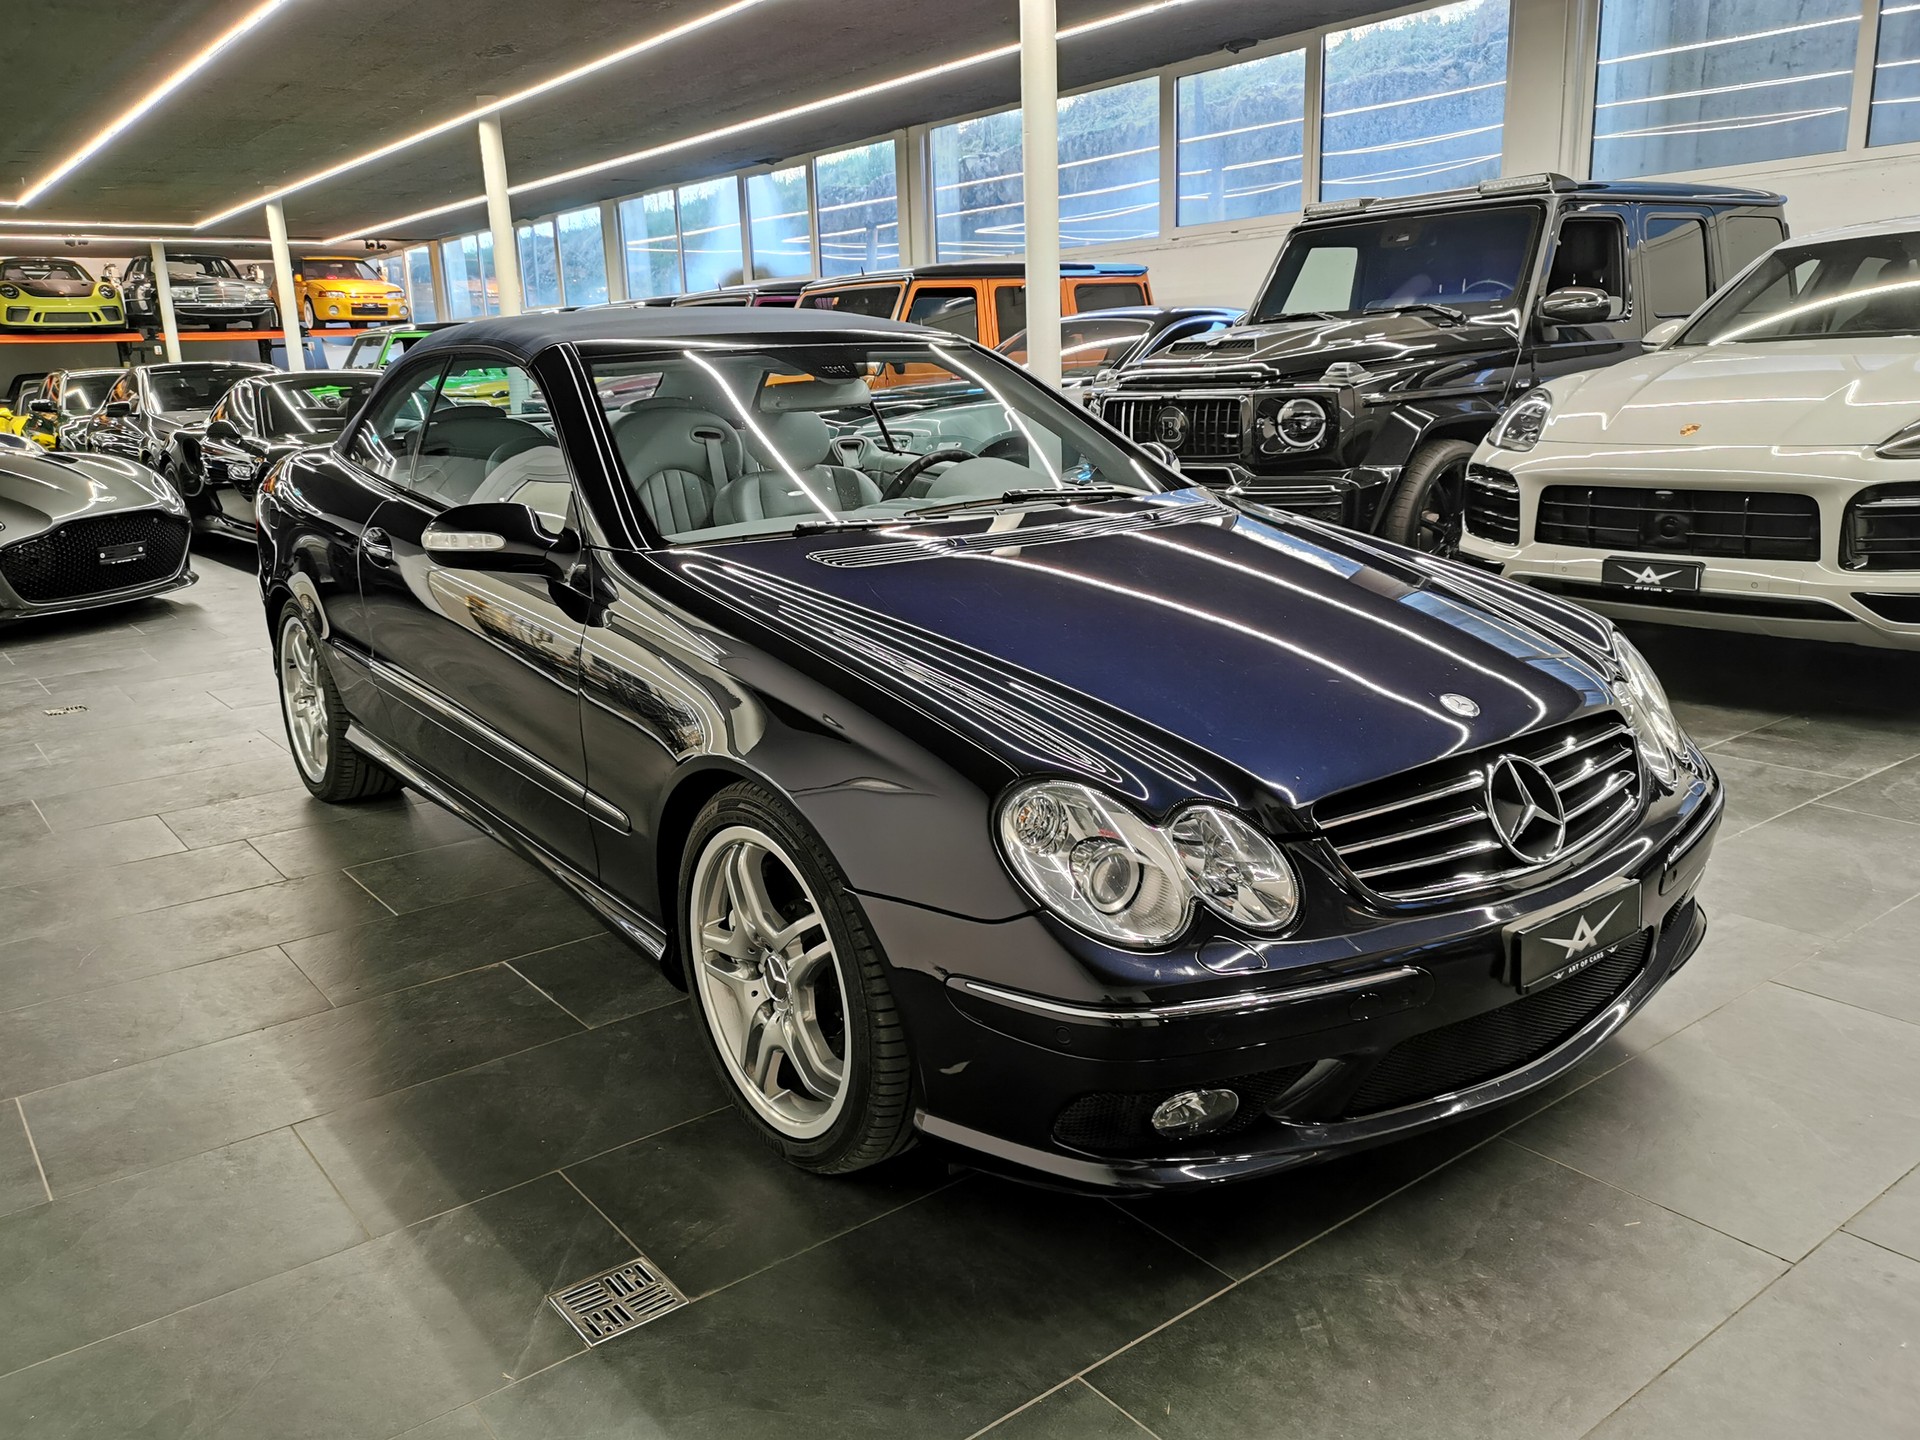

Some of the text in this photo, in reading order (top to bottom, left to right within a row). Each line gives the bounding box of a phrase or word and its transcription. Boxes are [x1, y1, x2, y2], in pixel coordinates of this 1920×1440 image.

[1568, 952, 1604, 973] ART OF CARS
